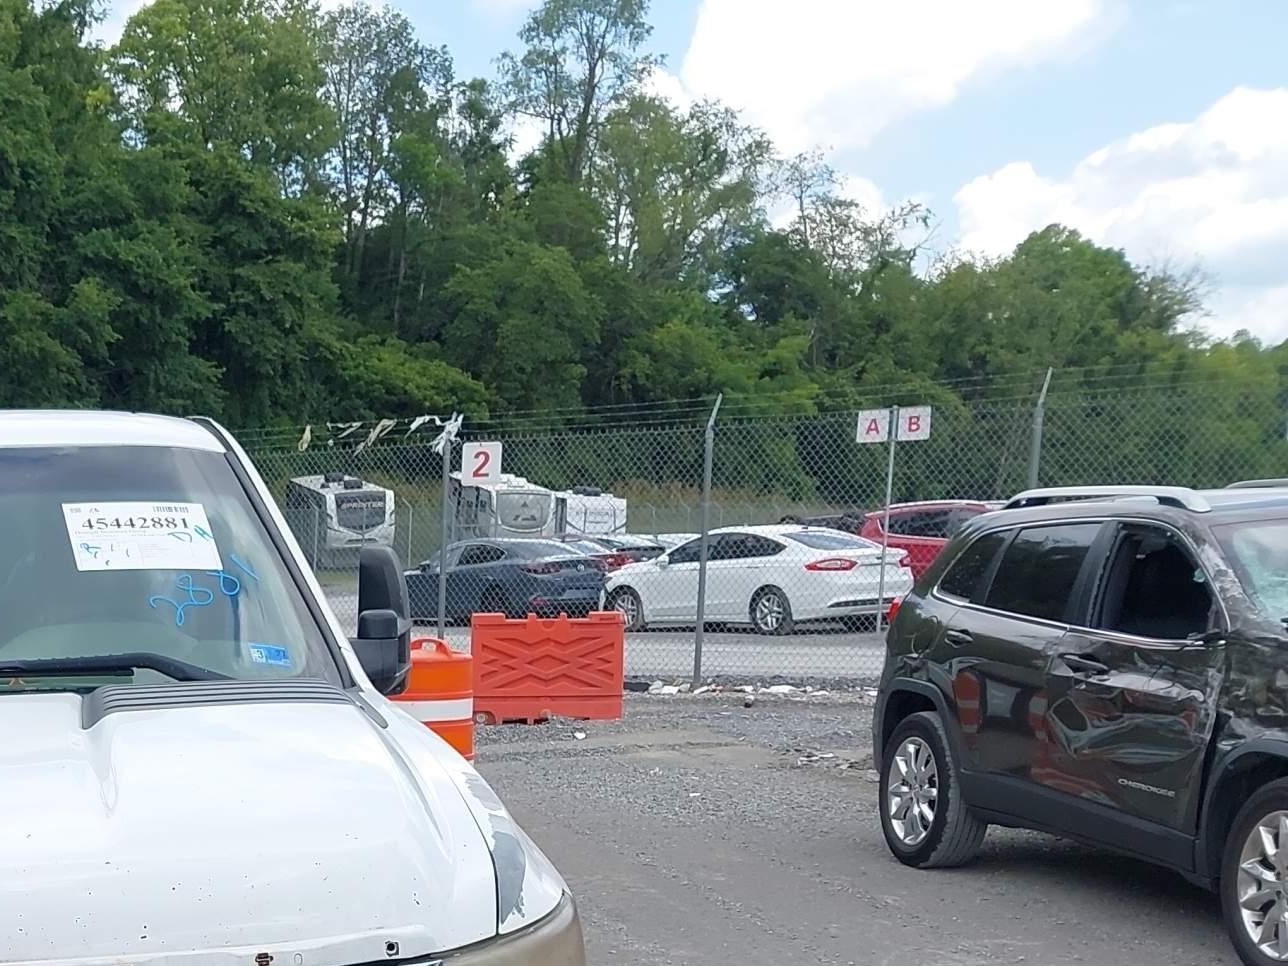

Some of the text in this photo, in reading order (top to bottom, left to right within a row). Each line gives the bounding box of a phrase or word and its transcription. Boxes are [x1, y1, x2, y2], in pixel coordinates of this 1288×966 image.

[865, 417, 881, 436] A
[907, 415, 921, 433] B
[472, 450, 491, 479] 2
[81, 515, 190, 531] 45442881
